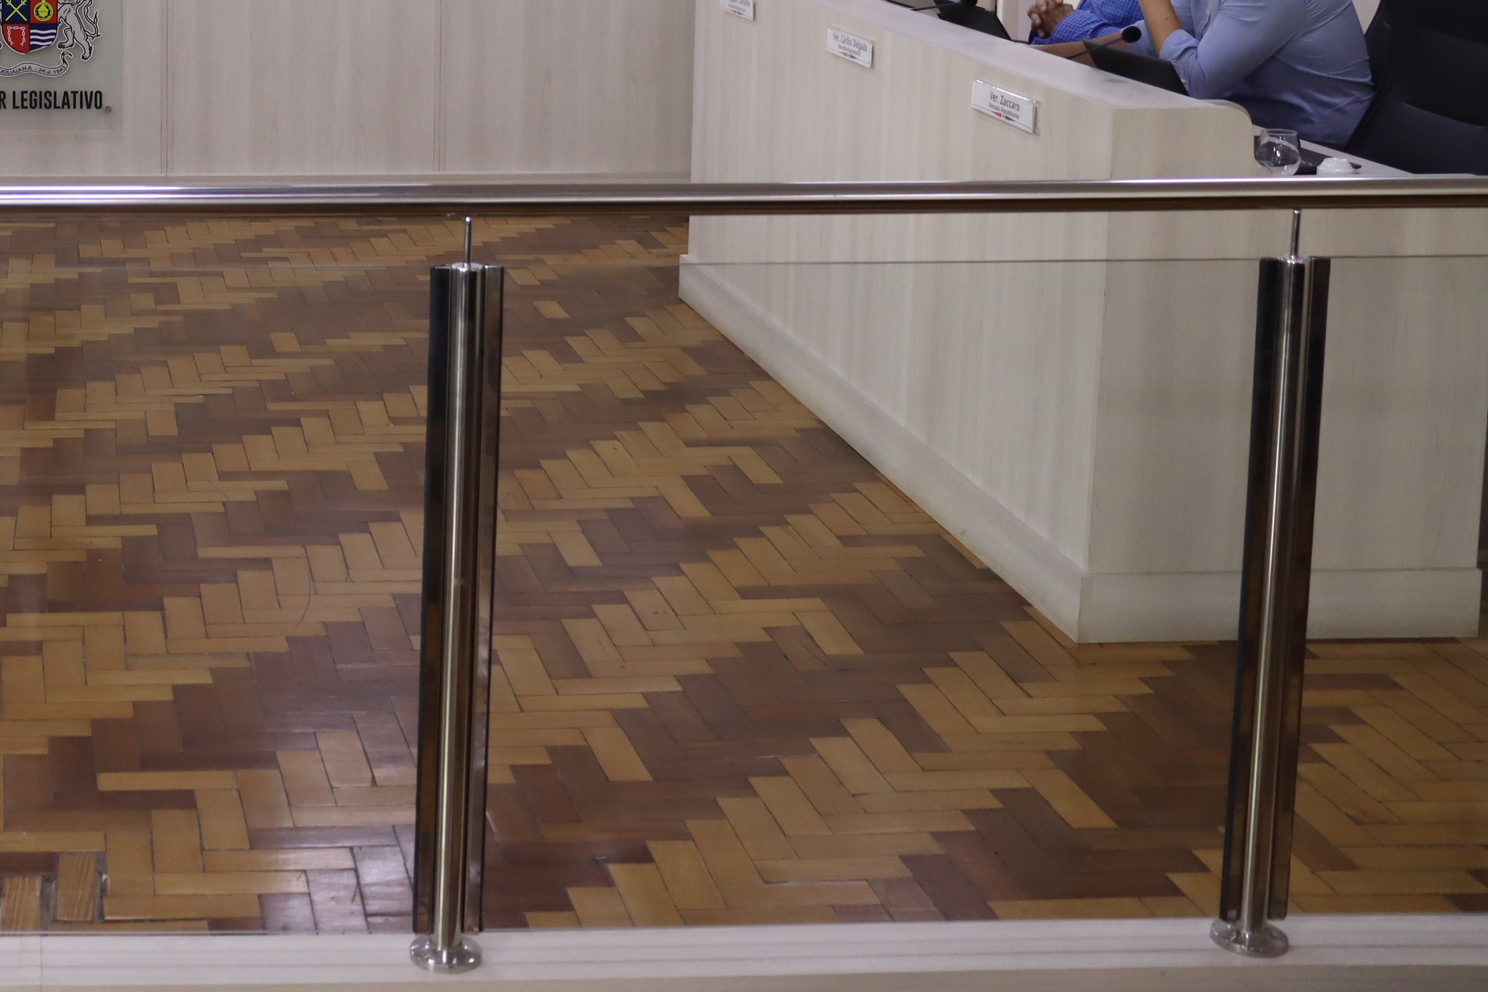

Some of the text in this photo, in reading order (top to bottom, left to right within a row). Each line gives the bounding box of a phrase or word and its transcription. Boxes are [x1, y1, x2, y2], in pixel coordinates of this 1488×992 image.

[12, 90, 103, 109] LEGISLATIVO
[990, 90, 1020, 112] Ver. Zaccaro
